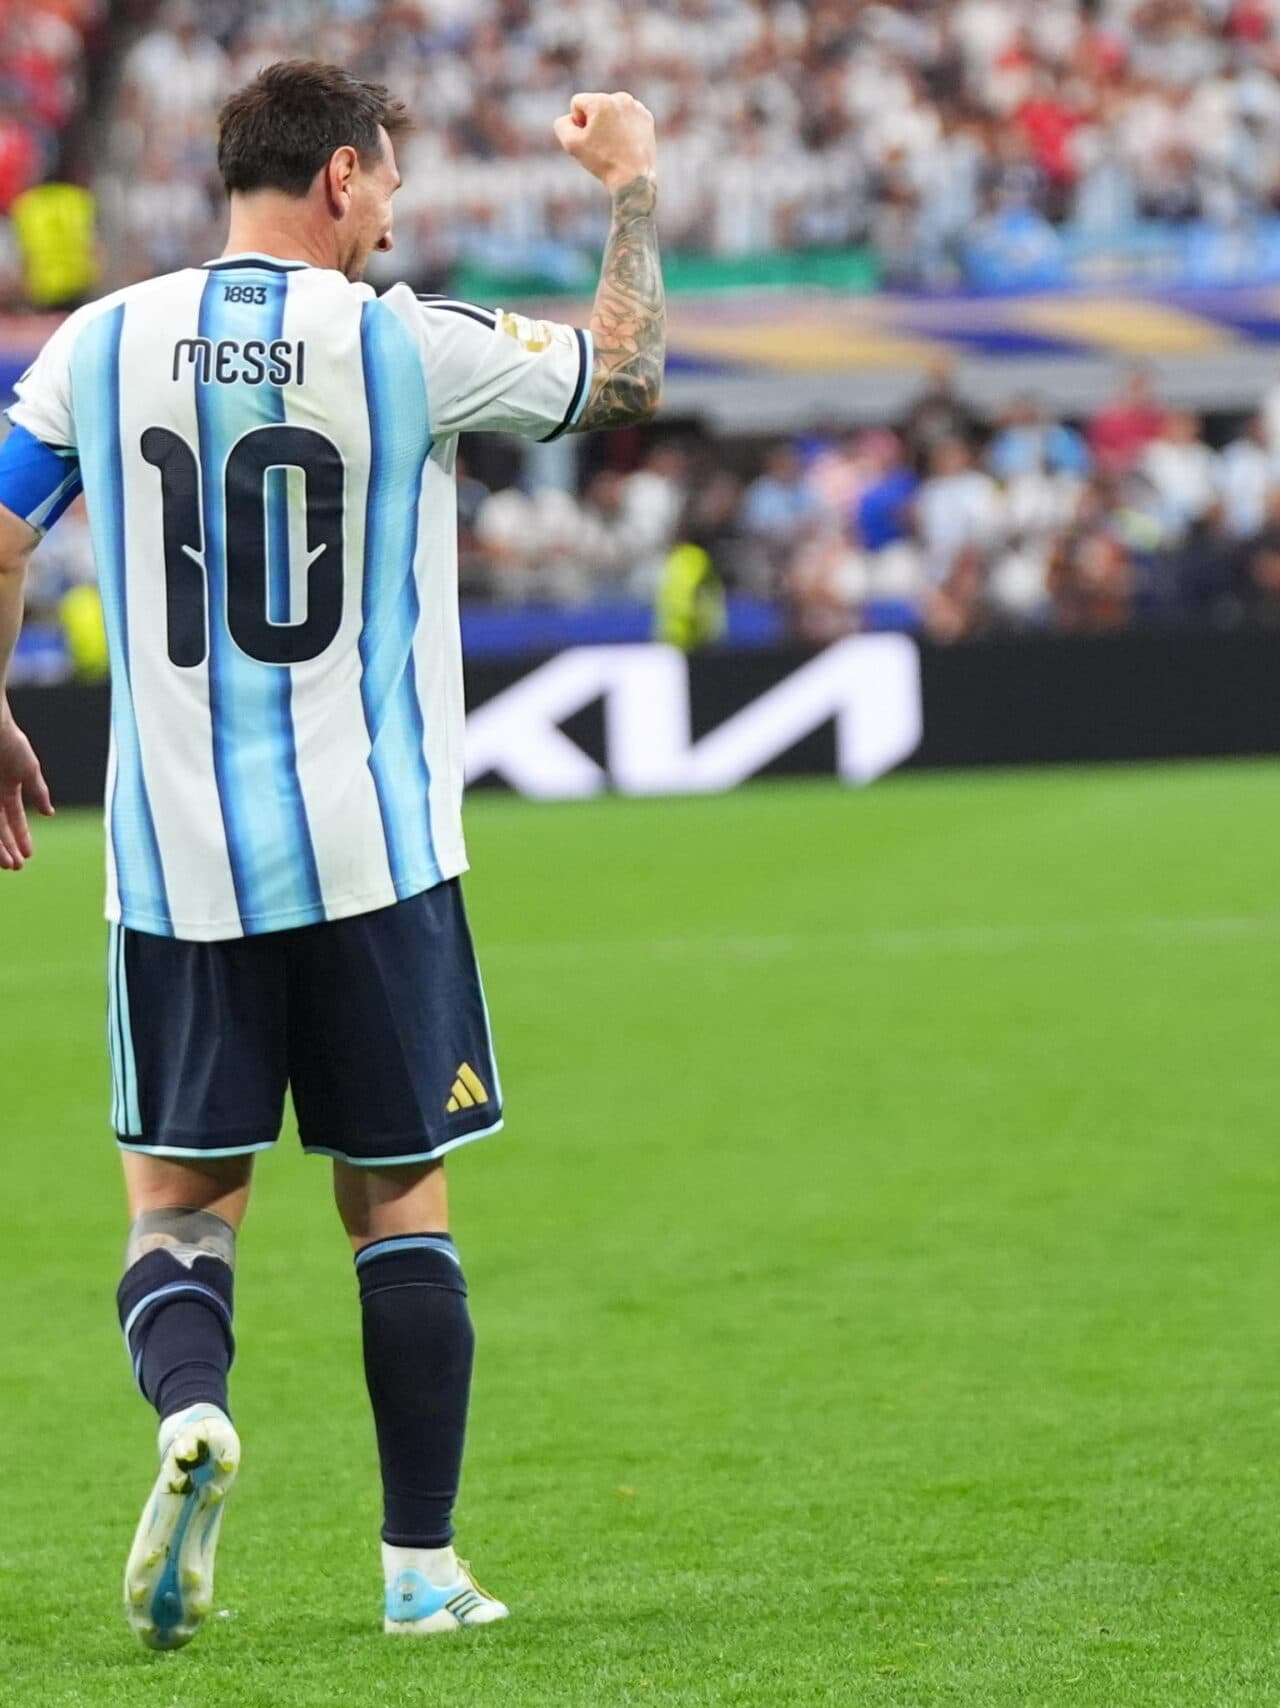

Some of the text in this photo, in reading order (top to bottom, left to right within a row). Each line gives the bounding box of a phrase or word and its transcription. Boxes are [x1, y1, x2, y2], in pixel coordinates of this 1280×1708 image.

[223, 285, 268, 306] 1893
[171, 337, 306, 387] MESSI
[139, 423, 345, 668] 10
